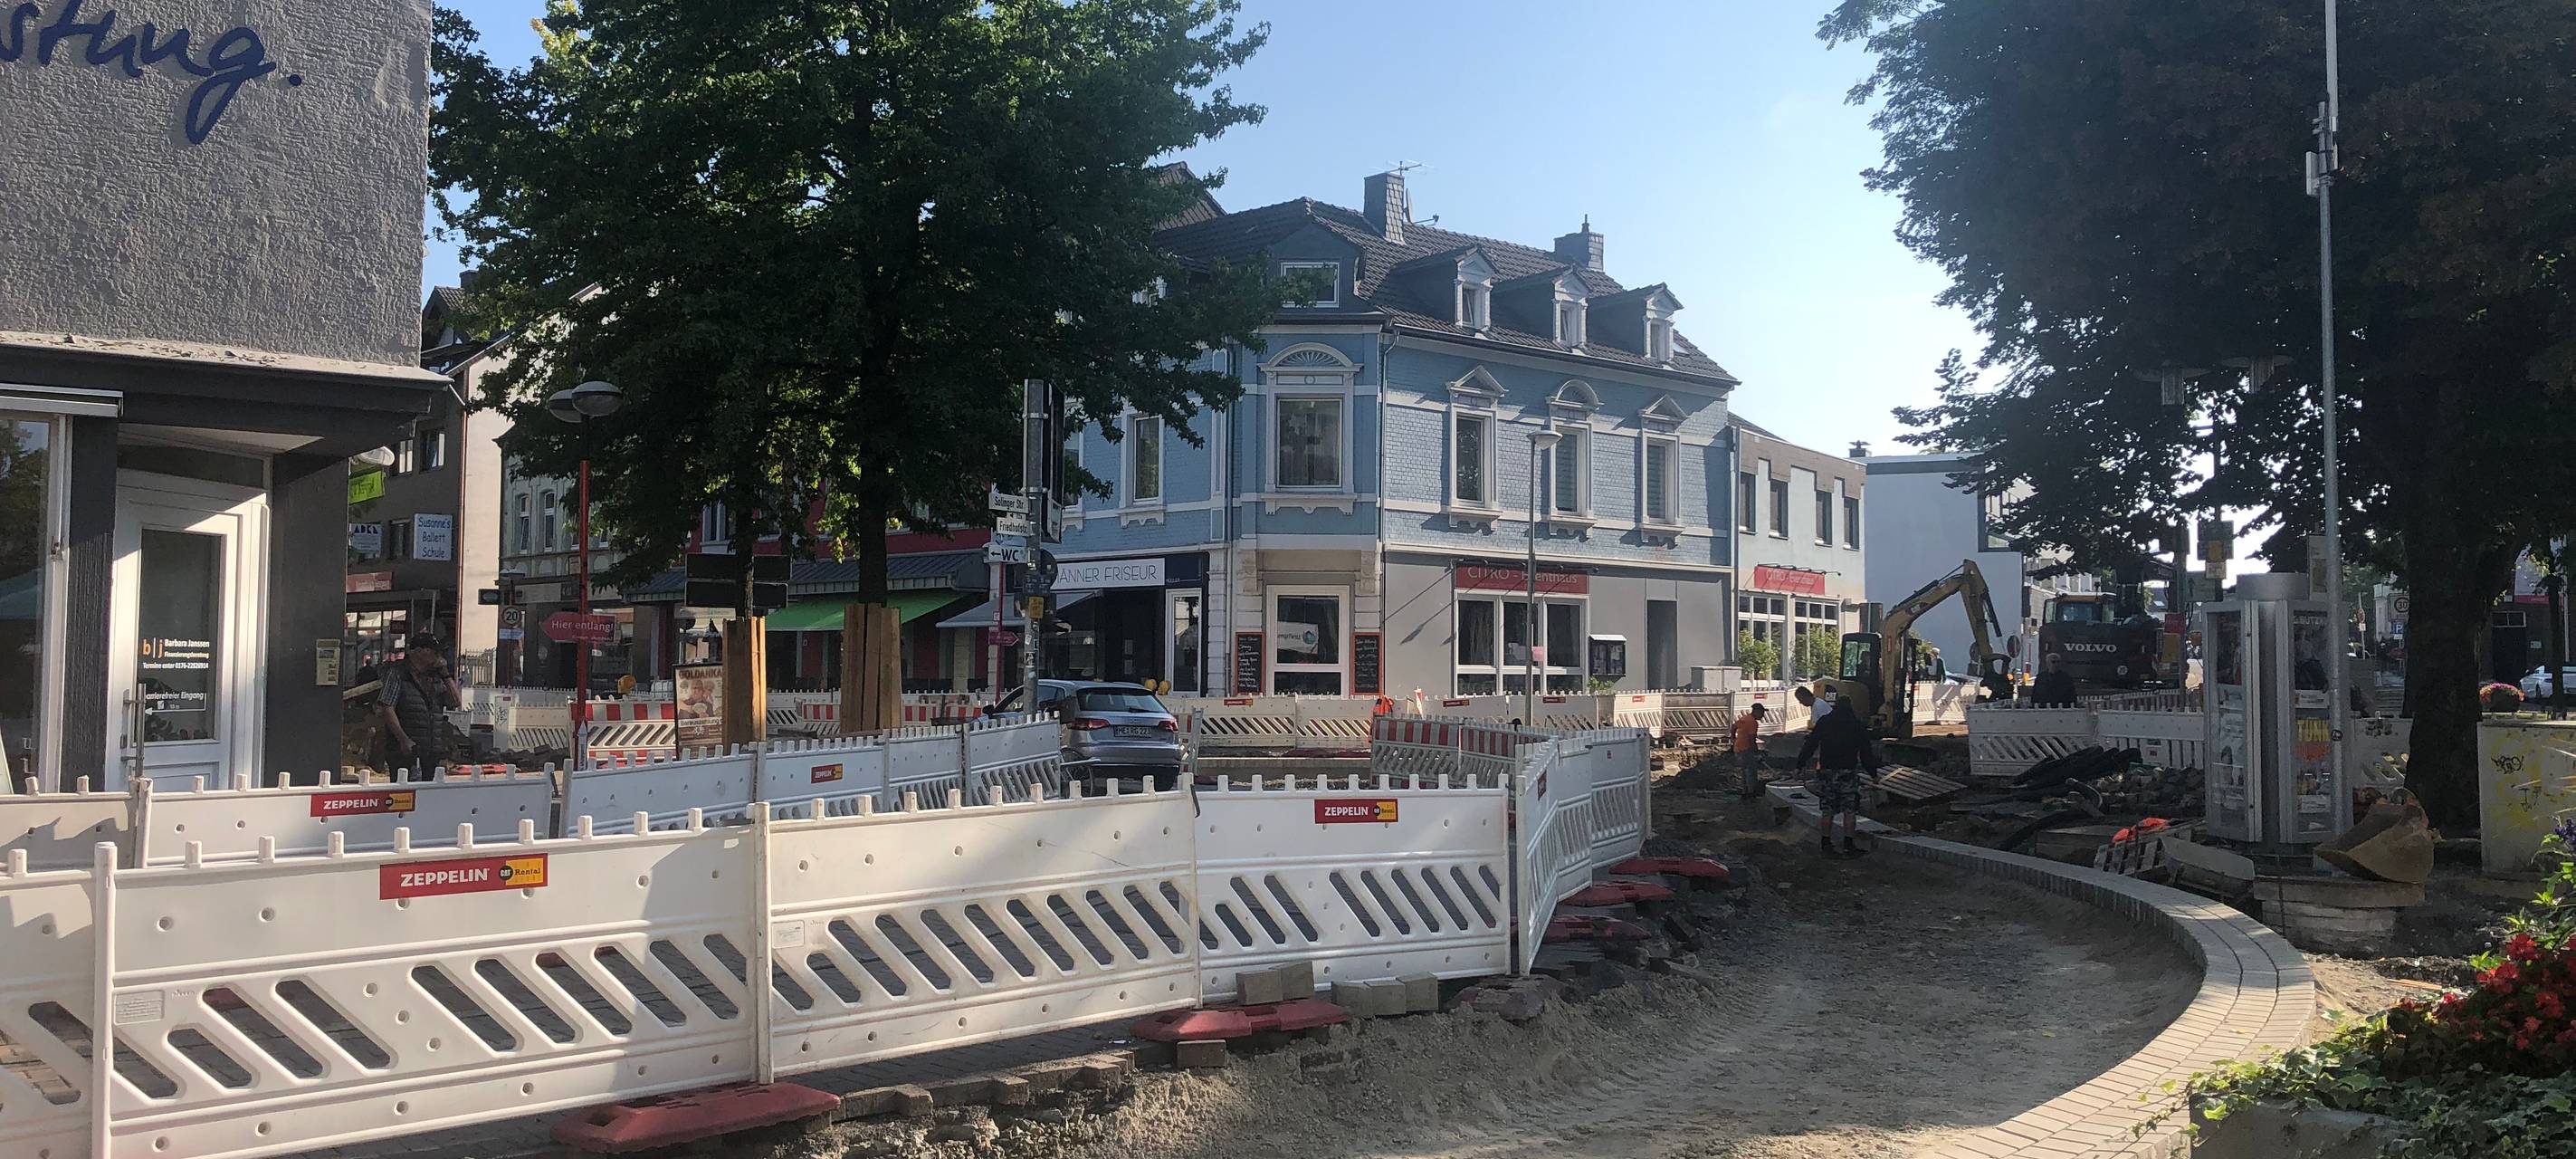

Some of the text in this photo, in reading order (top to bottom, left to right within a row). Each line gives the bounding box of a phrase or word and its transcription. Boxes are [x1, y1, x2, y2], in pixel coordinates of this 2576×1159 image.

[994, 496, 1025, 510] Solinger Str.
[999, 521, 1028, 534] Friedhofstr.
[422, 532, 445, 542] Ballett
[422, 548, 445, 558] Schule
[1001, 548, 1019, 561] WC
[1104, 565, 1158, 581] FRISEUR
[1467, 566, 1510, 580] CITRO
[2398, 600, 2409, 608] 30
[506, 610, 518, 621] 20
[551, 620, 615, 633] Hier entlang!
[2396, 625, 2403, 634] P
[164, 638, 210, 648] Barbara Janssen
[2064, 643, 2117, 653] VOLVO
[145, 691, 205, 701] arrierefreier Eingang
[1826, 692, 1837, 701] CAT
[323, 798, 378, 809] ZEPPELIN
[1324, 806, 1369, 816] ZEPPELIN
[400, 867, 541, 887] ZEPPELIN CAT Rental
